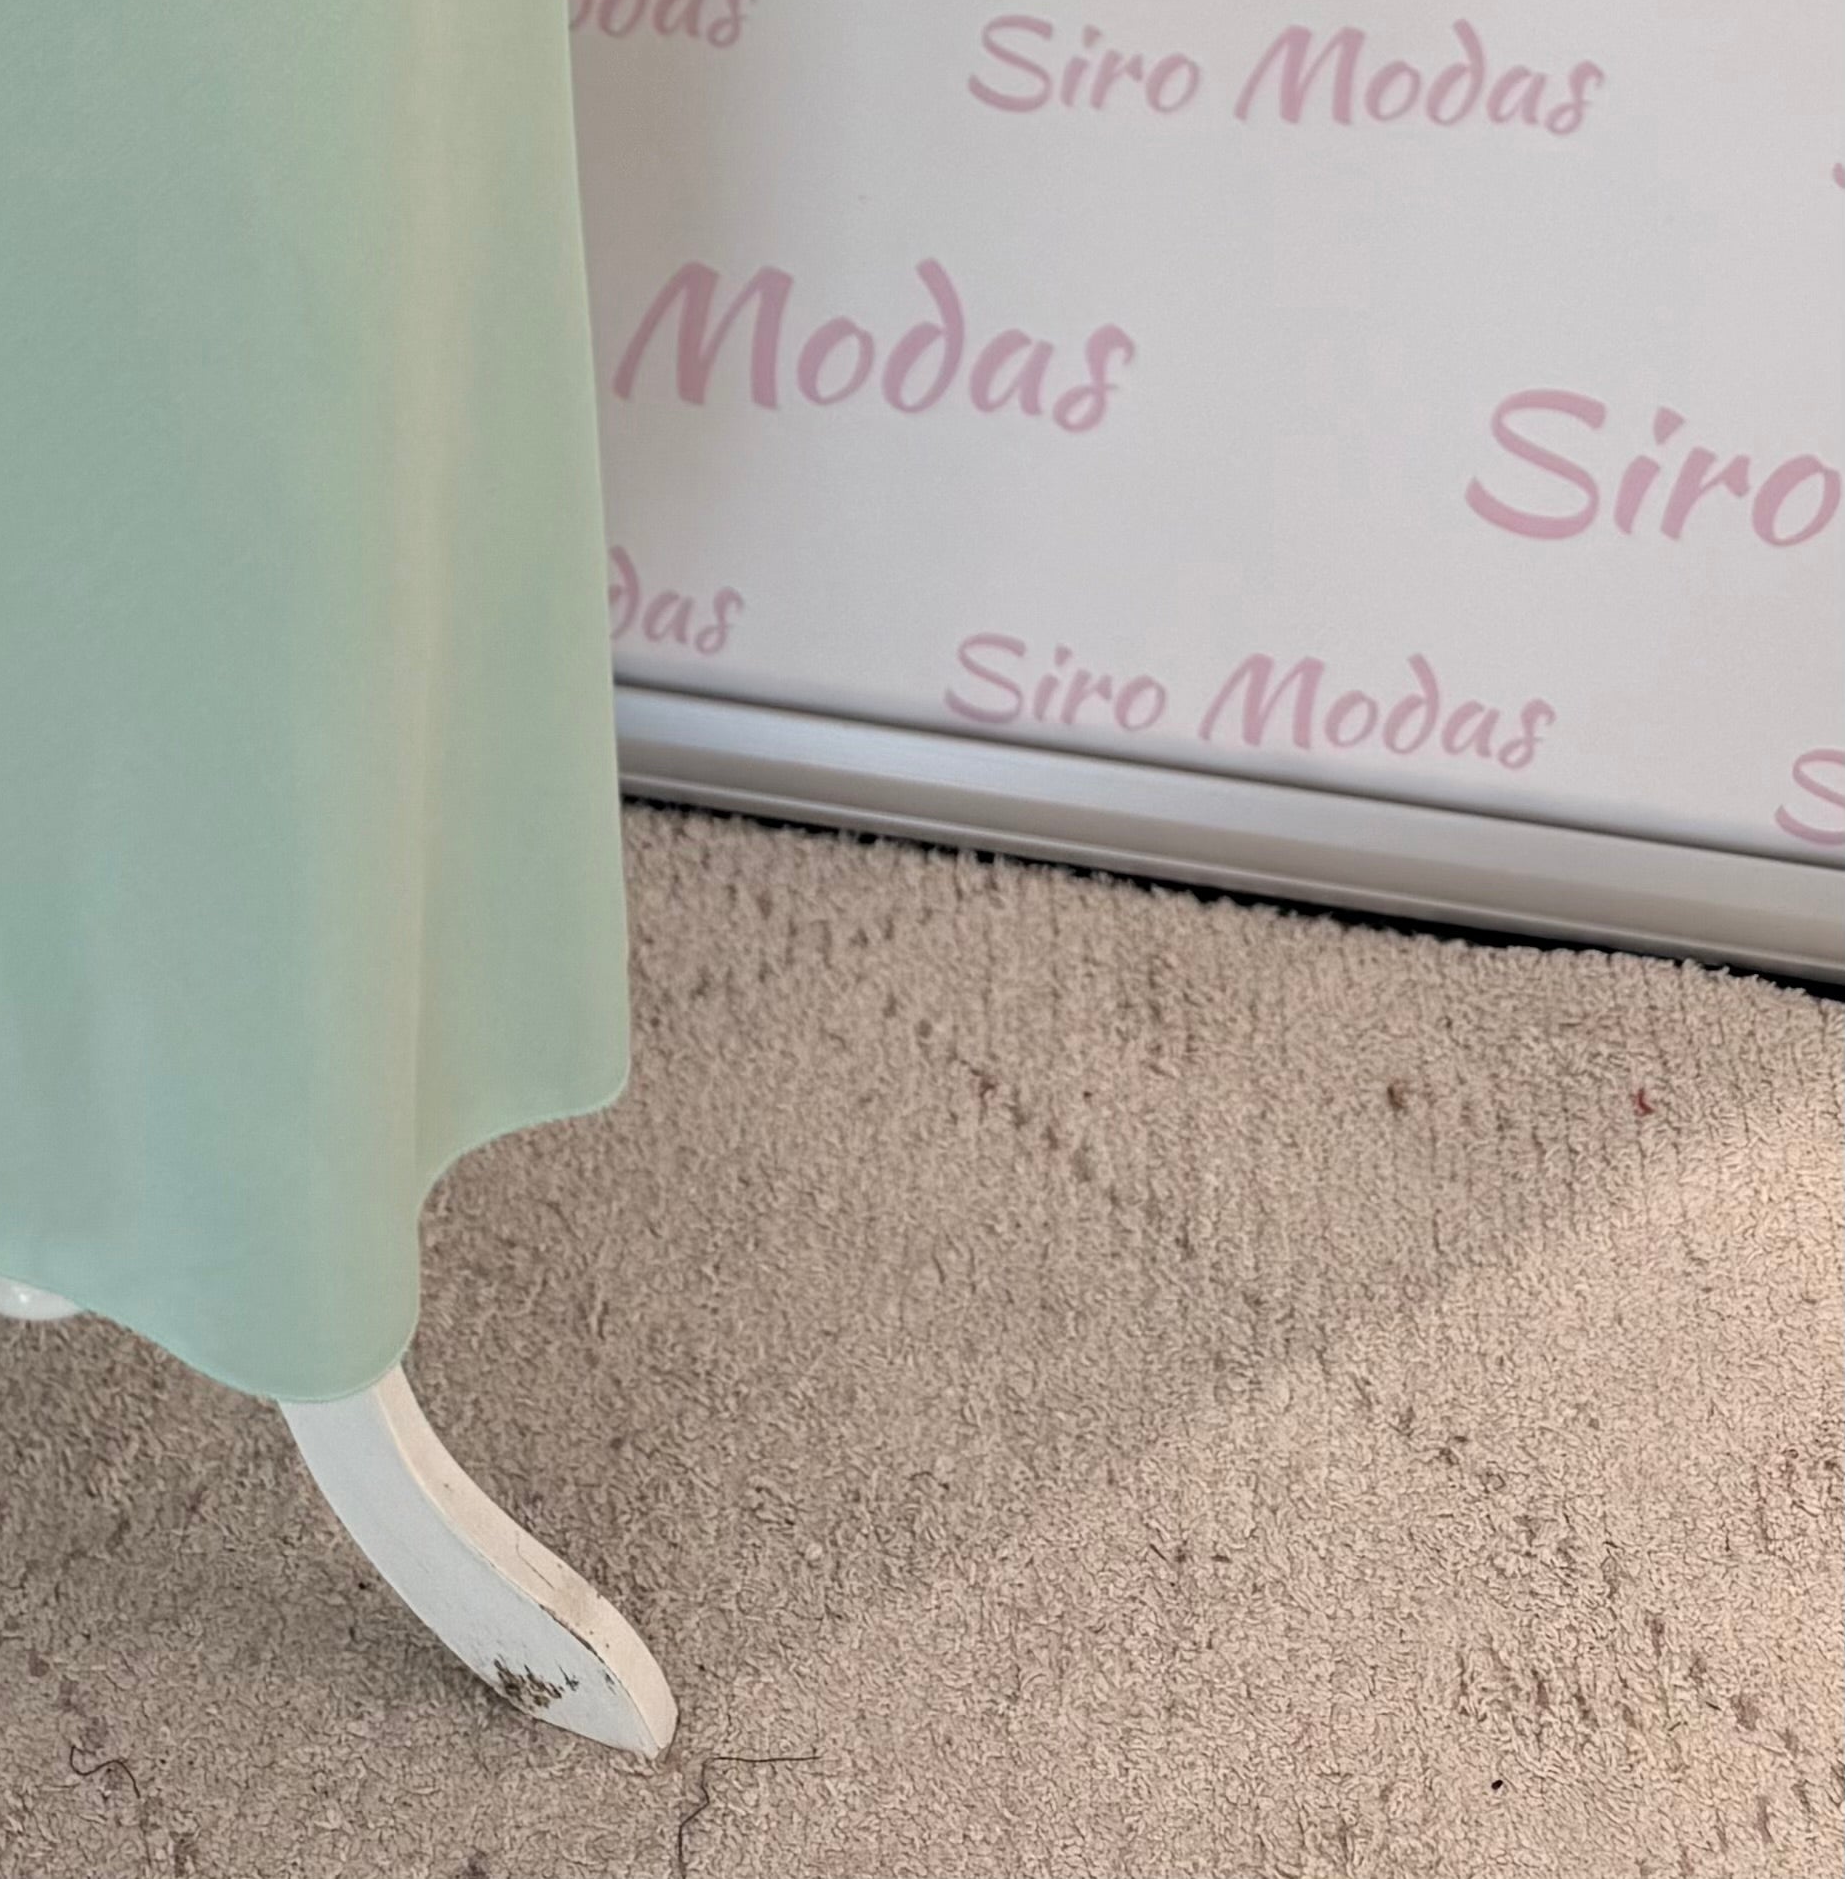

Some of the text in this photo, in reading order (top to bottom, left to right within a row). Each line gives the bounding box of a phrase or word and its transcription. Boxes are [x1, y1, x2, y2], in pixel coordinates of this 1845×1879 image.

[968, 15, 1603, 135] Siro Modas
[611, 260, 1133, 434] Modas
[1466, 391, 1842, 546] Siro
[946, 634, 1556, 771] Siro Modas
